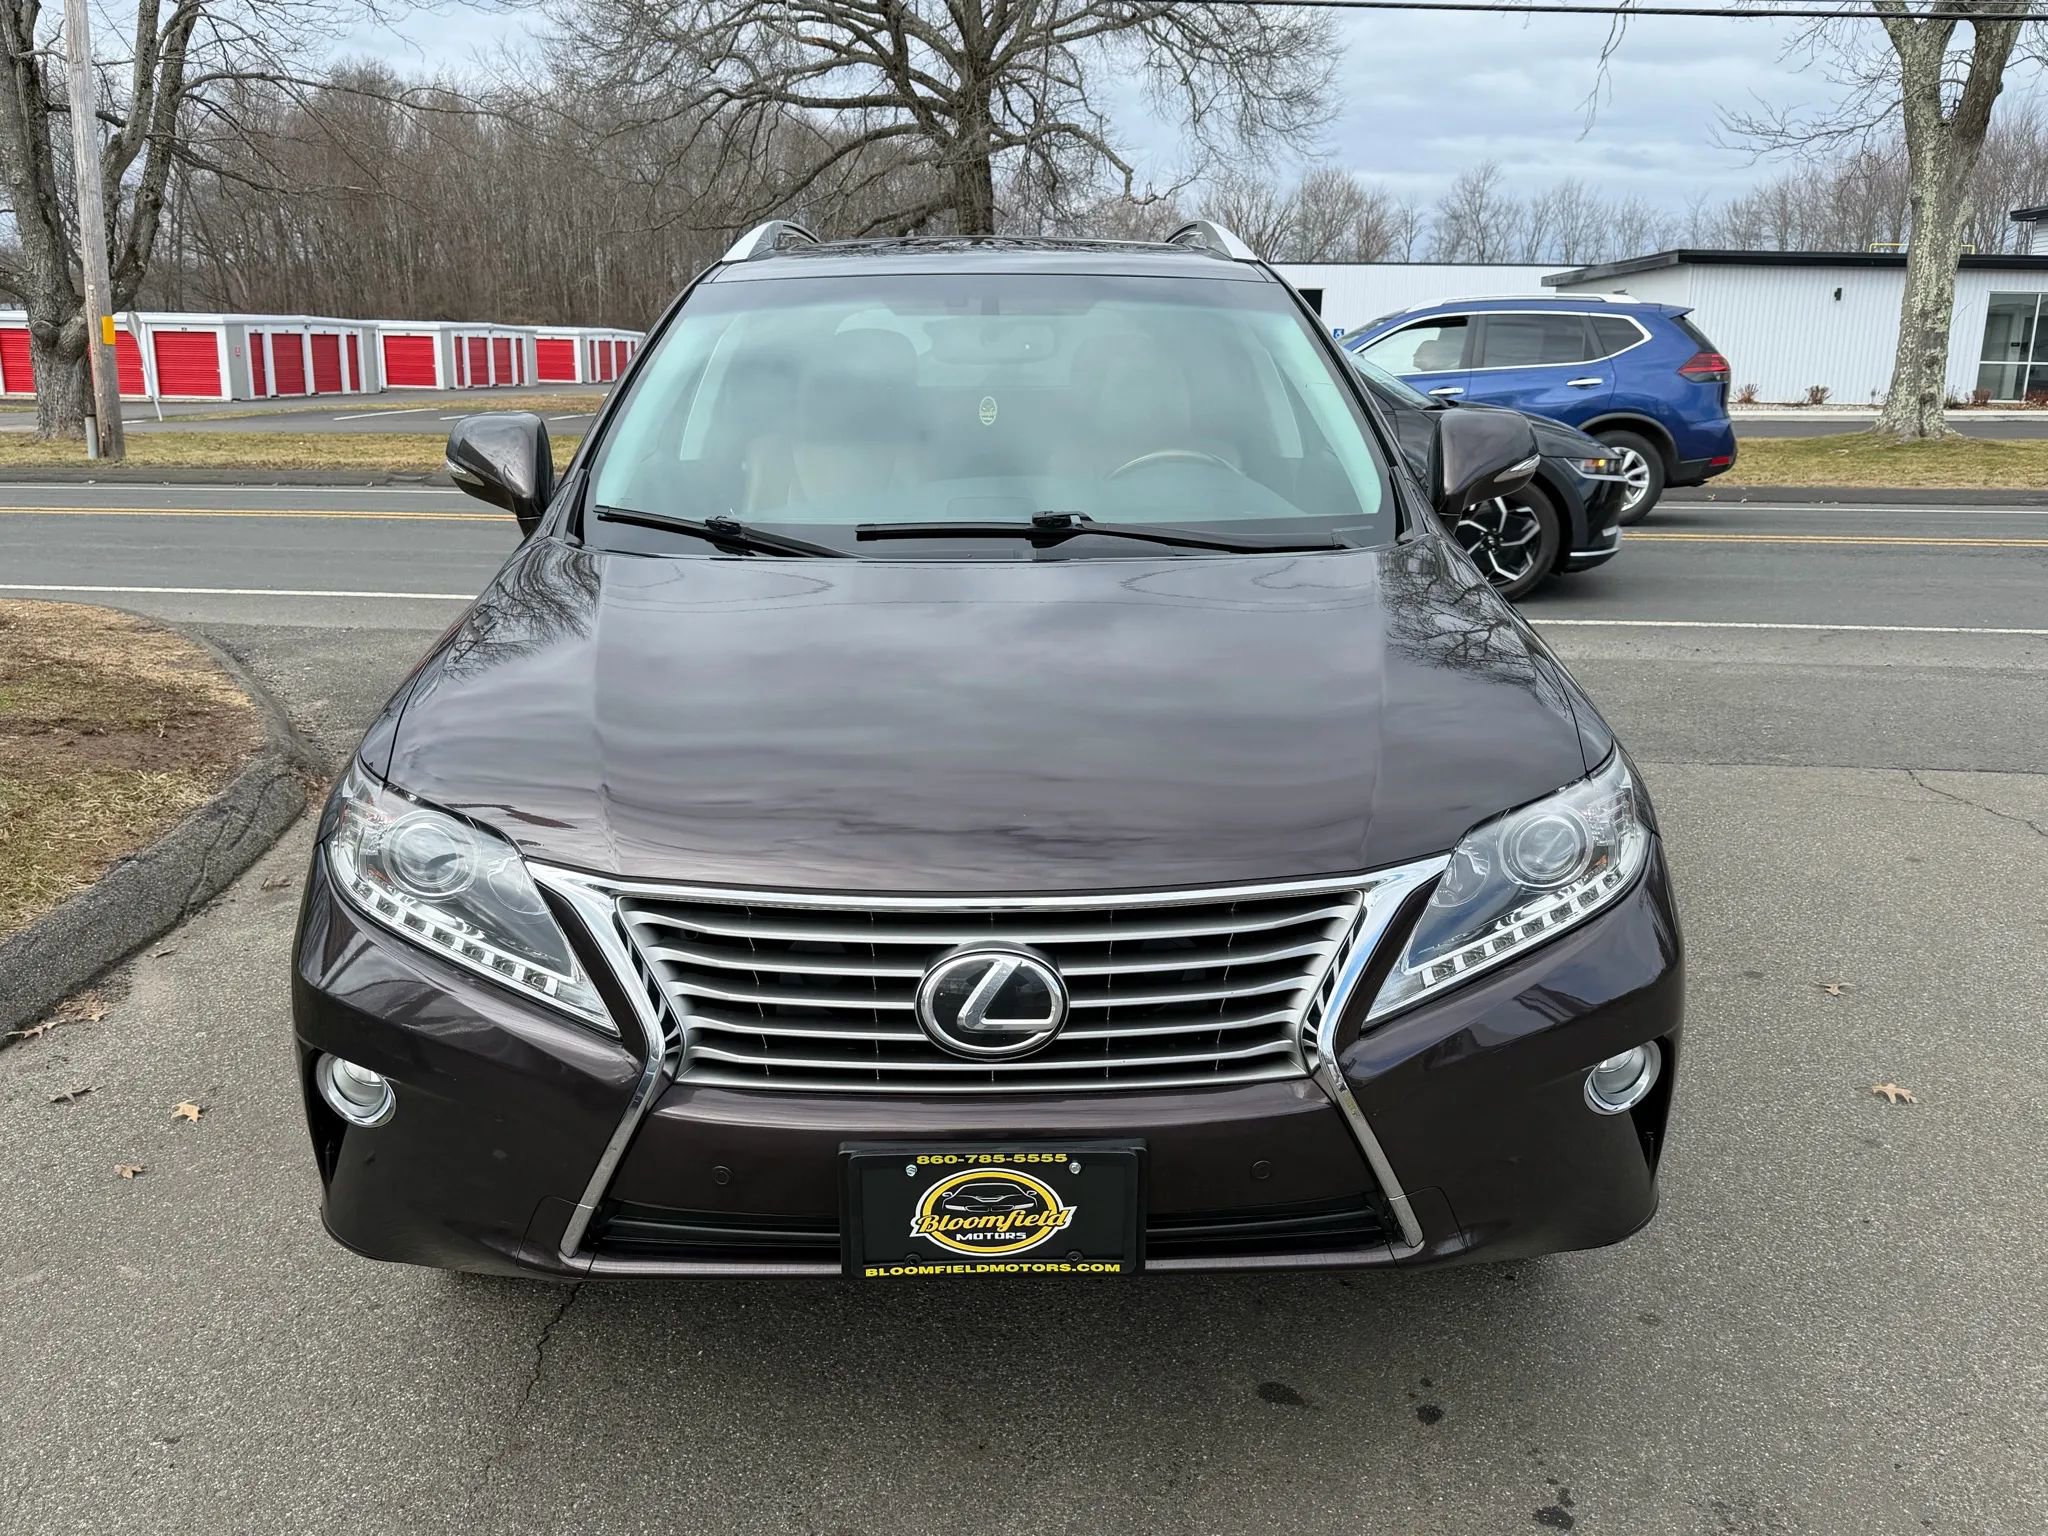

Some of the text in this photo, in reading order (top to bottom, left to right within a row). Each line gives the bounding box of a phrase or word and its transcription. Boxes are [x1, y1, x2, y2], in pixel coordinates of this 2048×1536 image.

[916, 1154, 1068, 1165] 860-785-5555
[917, 1209, 1071, 1233] Bloomfield
[955, 1231, 1027, 1241] MOTORS
[865, 1263, 1121, 1277] BLOOMFIELDMOTORS.COM
